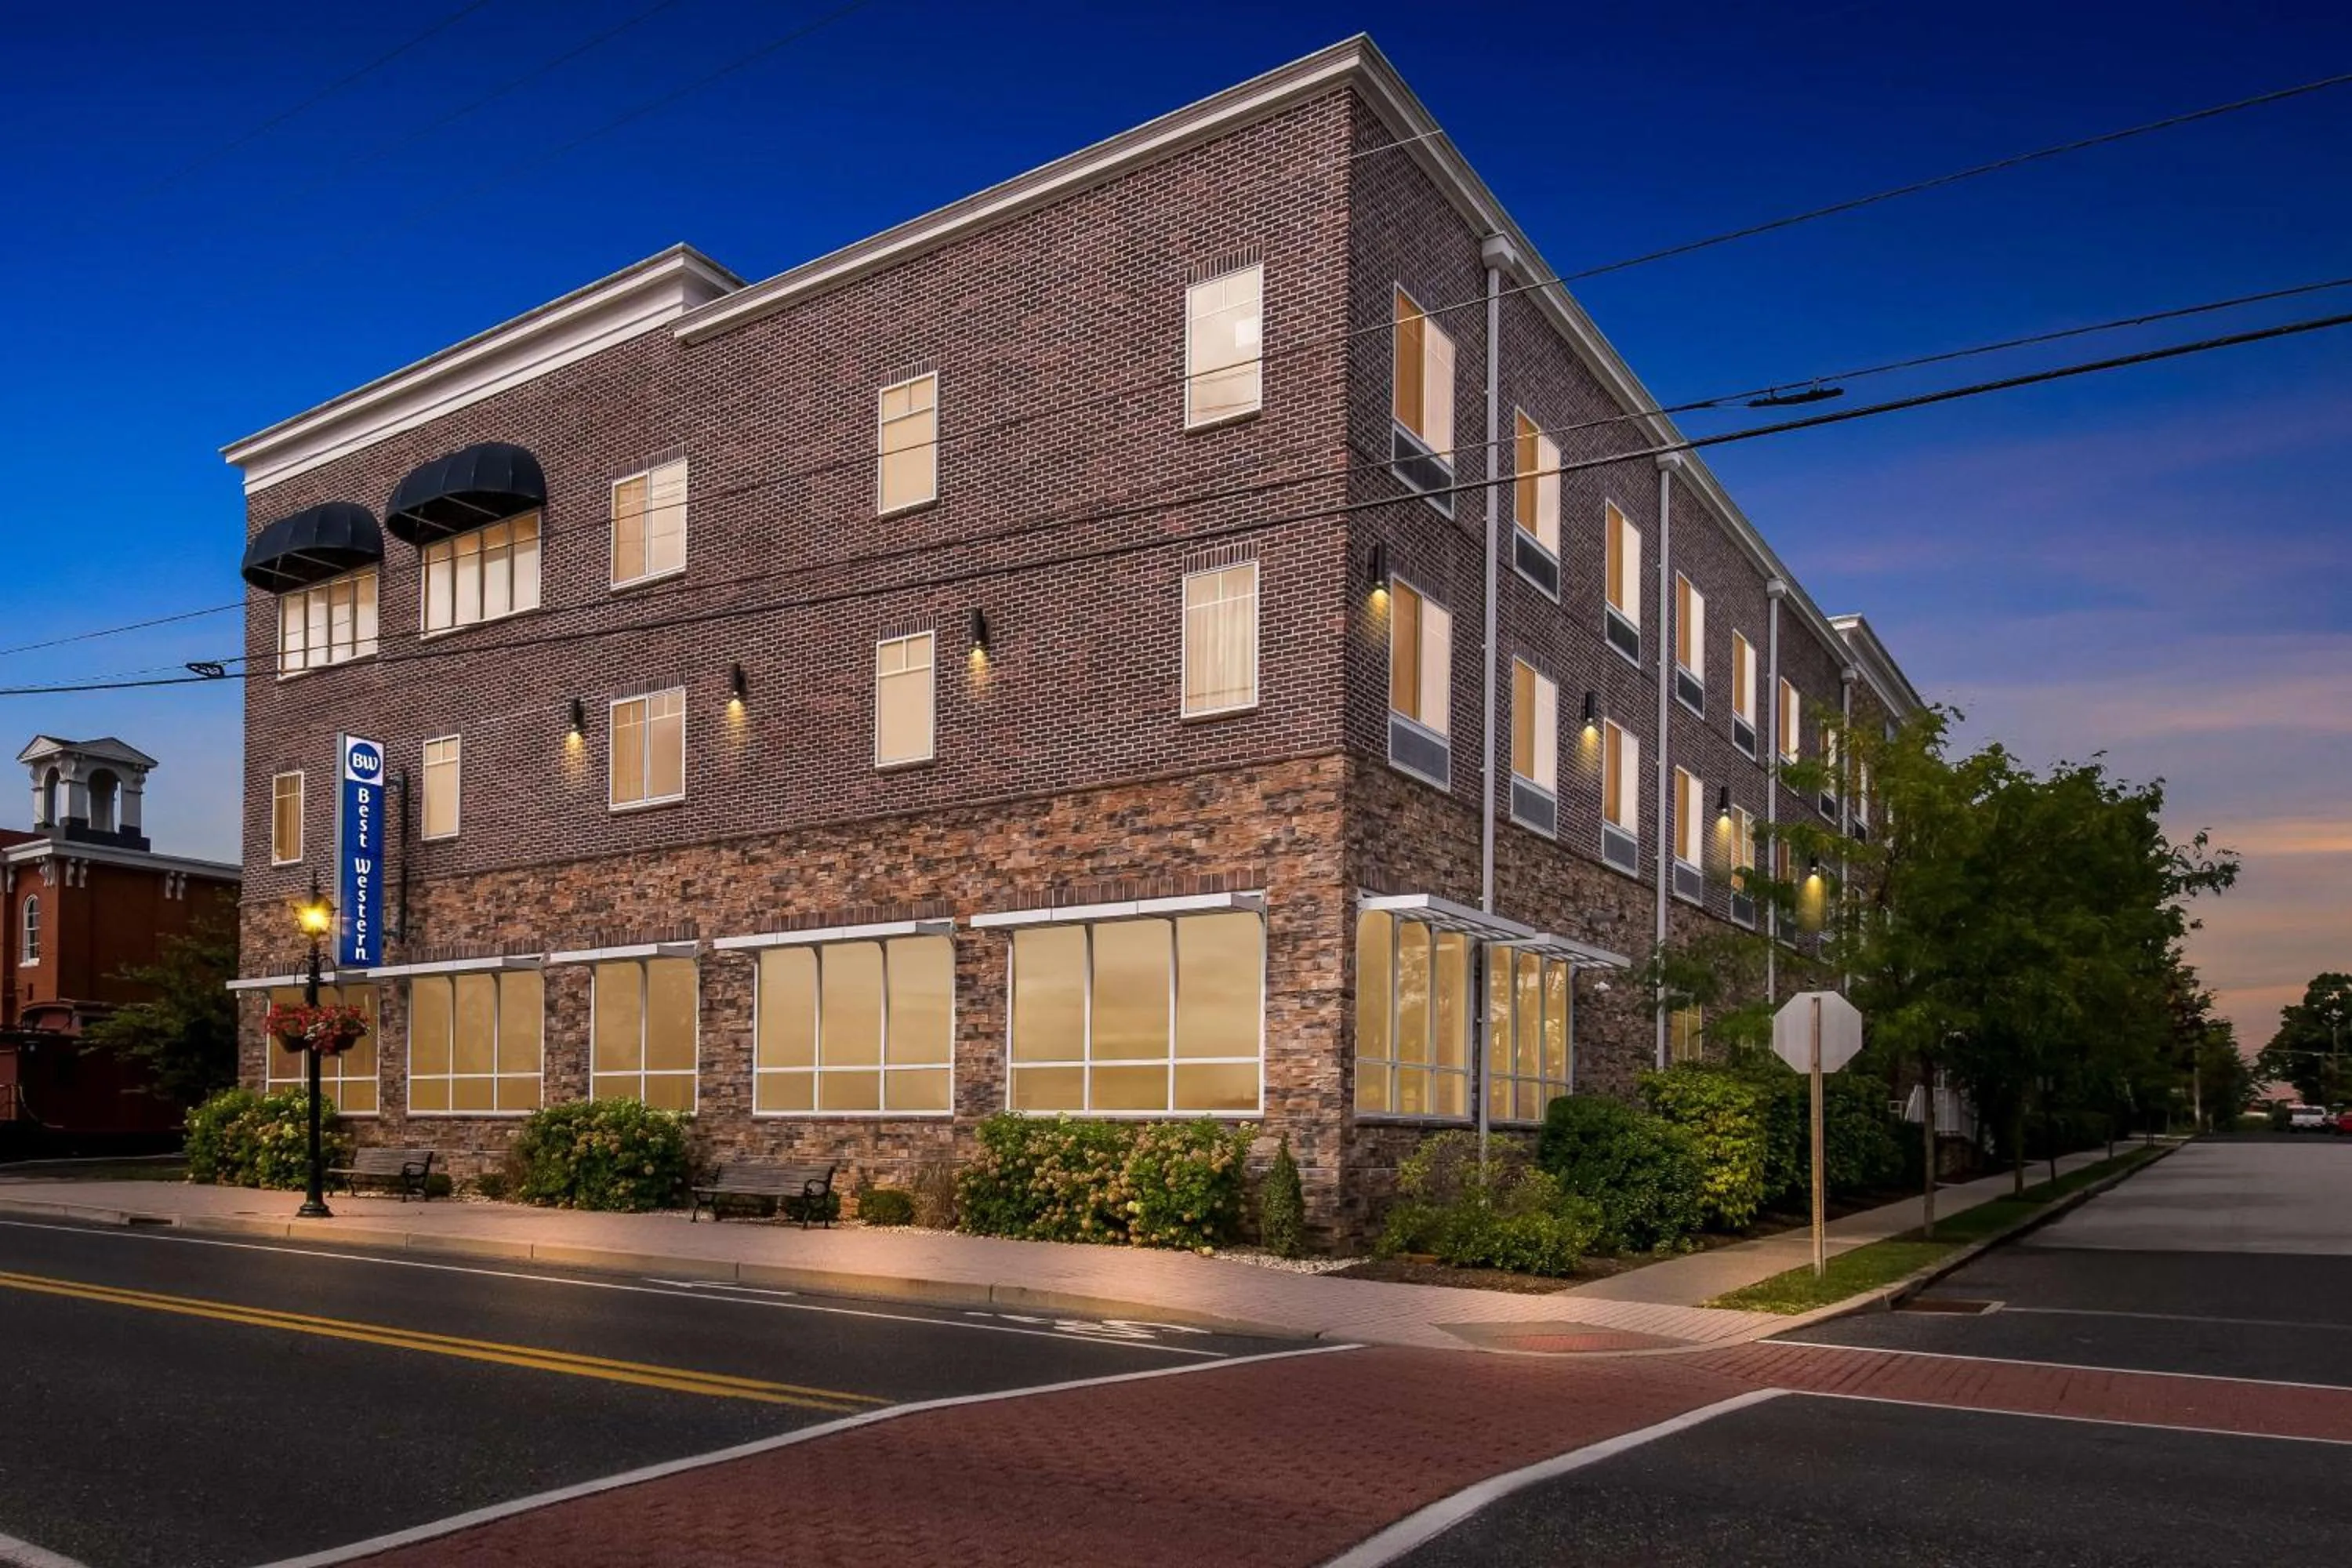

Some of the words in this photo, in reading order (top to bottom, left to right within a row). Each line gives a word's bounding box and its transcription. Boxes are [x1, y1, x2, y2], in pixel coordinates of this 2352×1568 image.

[352, 752, 378, 771] BW
[358, 788, 370, 848] Best
[355, 858, 370, 960] Western
